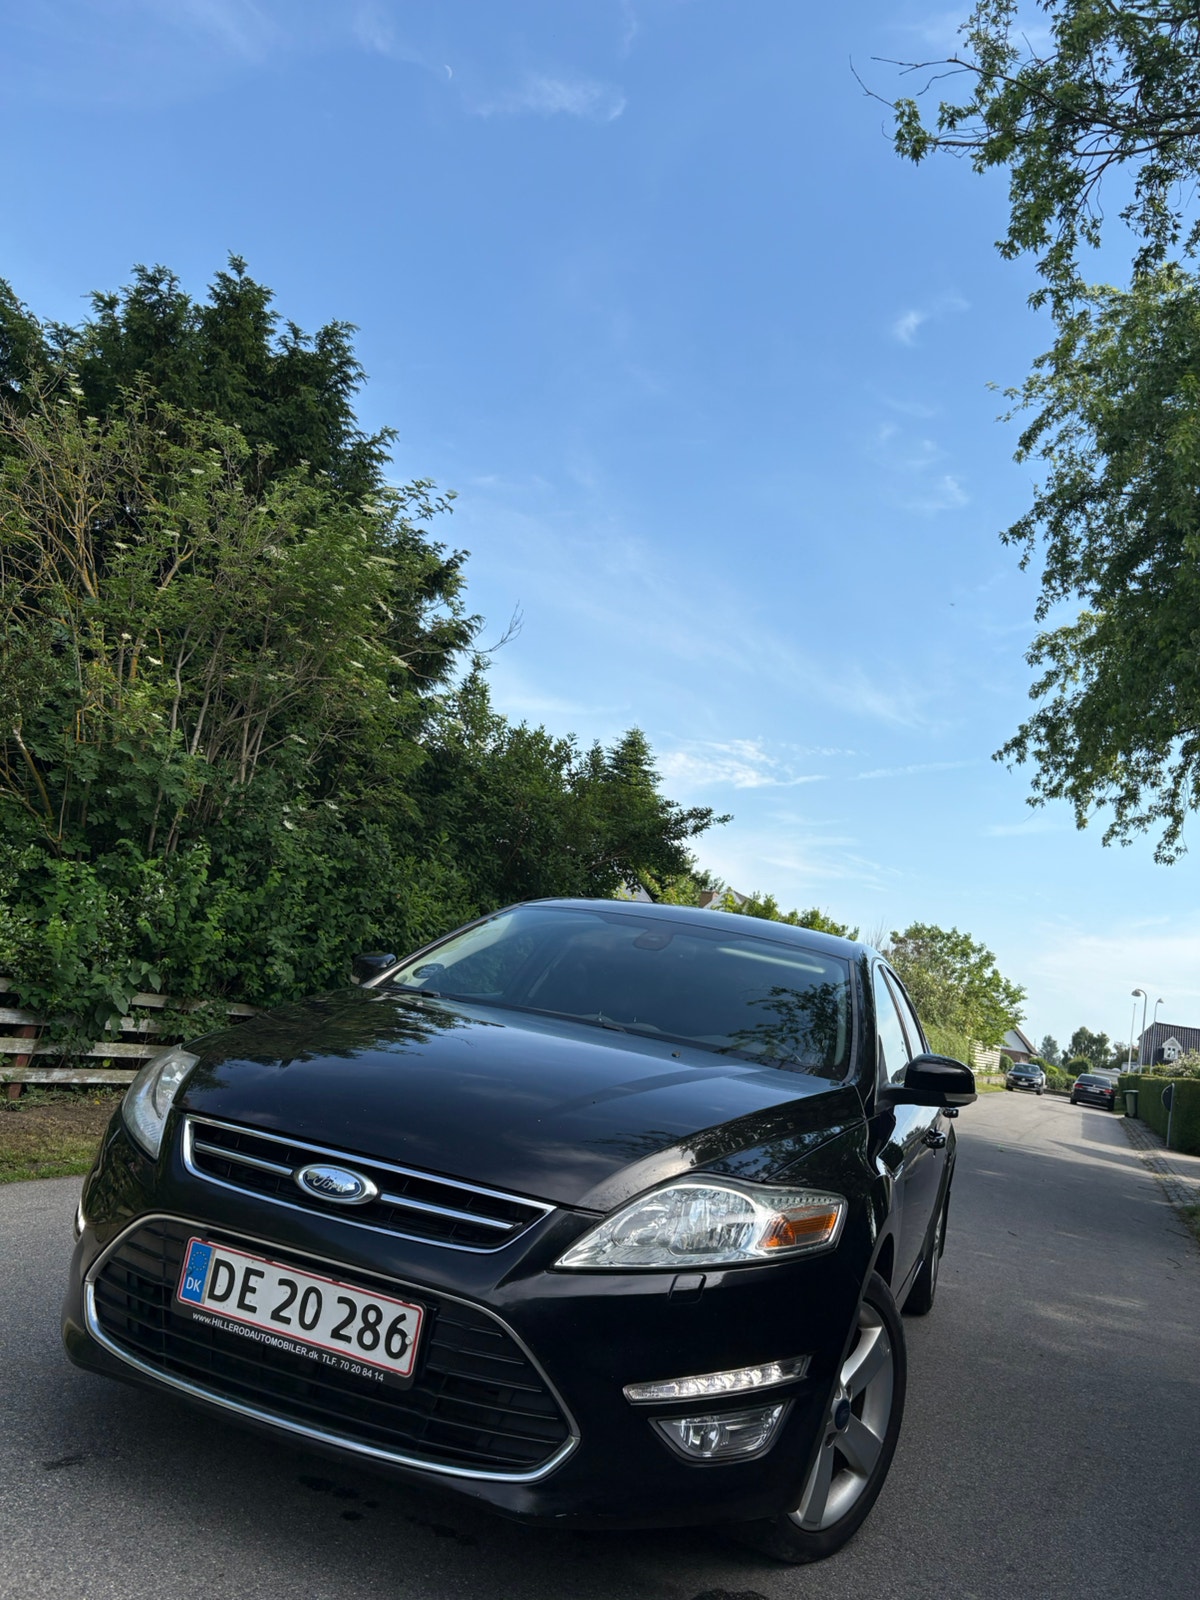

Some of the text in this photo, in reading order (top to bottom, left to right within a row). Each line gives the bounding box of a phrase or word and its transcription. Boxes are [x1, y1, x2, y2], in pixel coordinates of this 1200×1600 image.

[186, 1277, 201, 1293] DK
[207, 1258, 408, 1360] DE 20 286
[322, 1354, 338, 1367] TLF.
[340, 1360, 350, 1370] 70
[351, 1364, 361, 1374] 20
[362, 1368, 372, 1378] 84
[374, 1372, 384, 1382] 14
